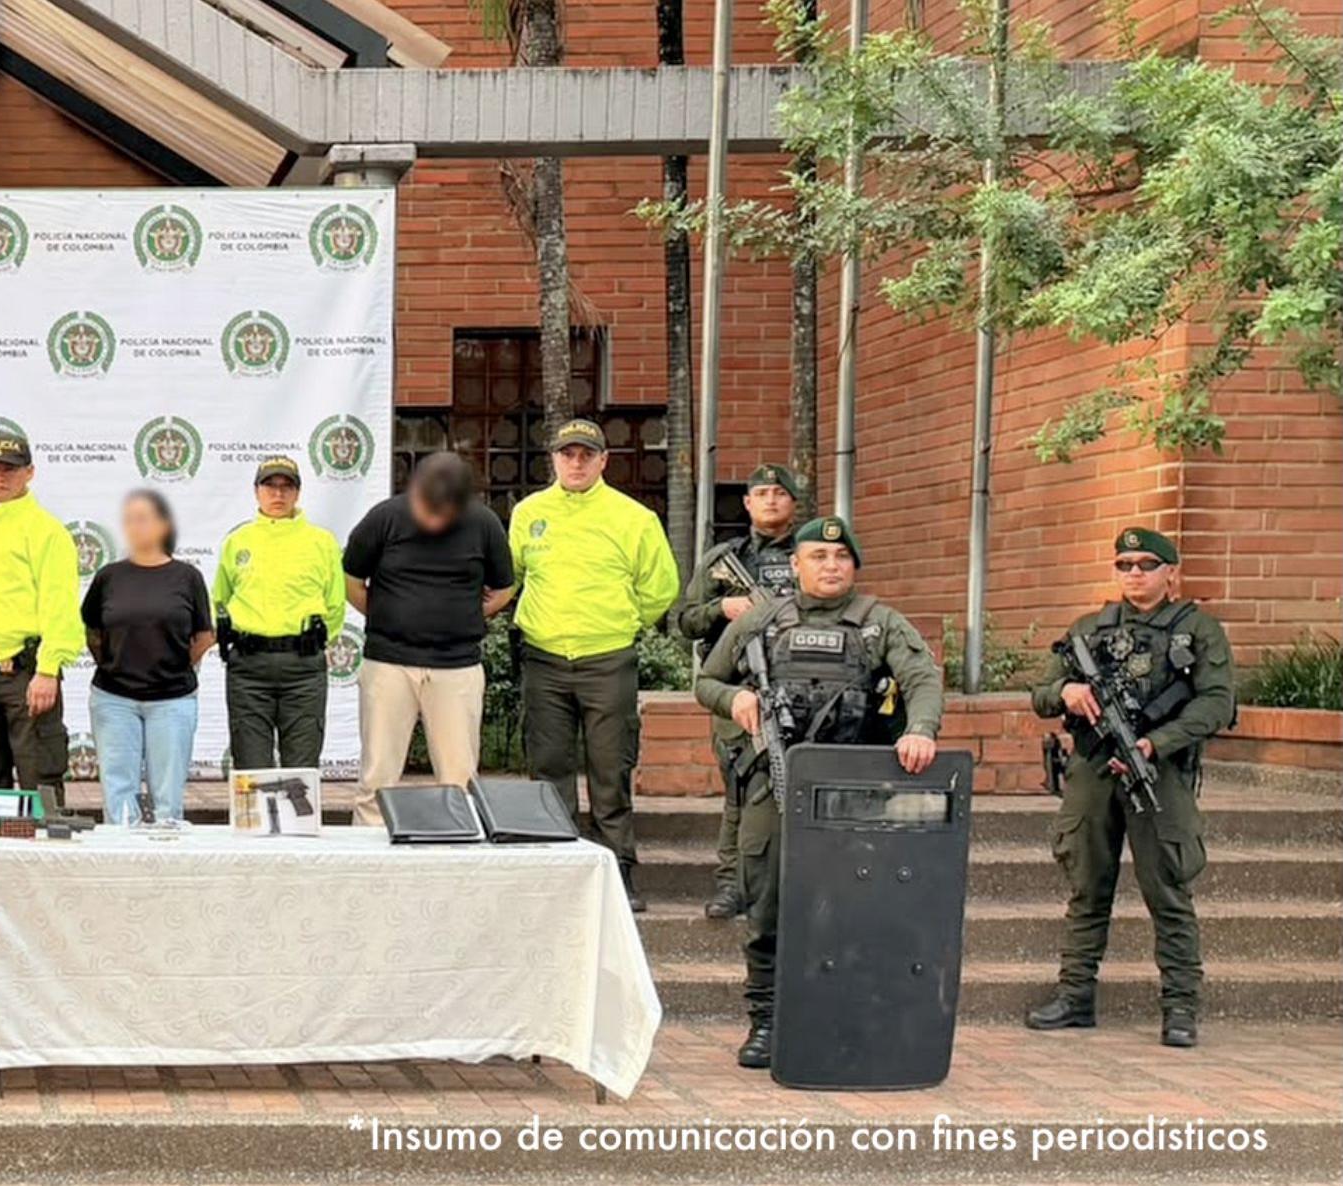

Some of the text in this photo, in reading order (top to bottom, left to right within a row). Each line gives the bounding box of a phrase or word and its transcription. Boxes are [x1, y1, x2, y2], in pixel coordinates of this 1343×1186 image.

[75, 231, 128, 241] NACIONAL
[249, 230, 302, 241] NACIONAL
[46, 243, 116, 252] DE COLOMBIA
[220, 242, 289, 252] DE COLOMBIA
[161, 337, 213, 347] NACIONAL
[336, 336, 387, 346] NACIONAL
[133, 348, 201, 358] DE COLOMBIA
[307, 347, 375, 357] DE COLOMBIA
[47, 453, 116, 463] DE COLOMBIA
[764, 568, 791, 579] GOE
[795, 634, 837, 646] GOES
